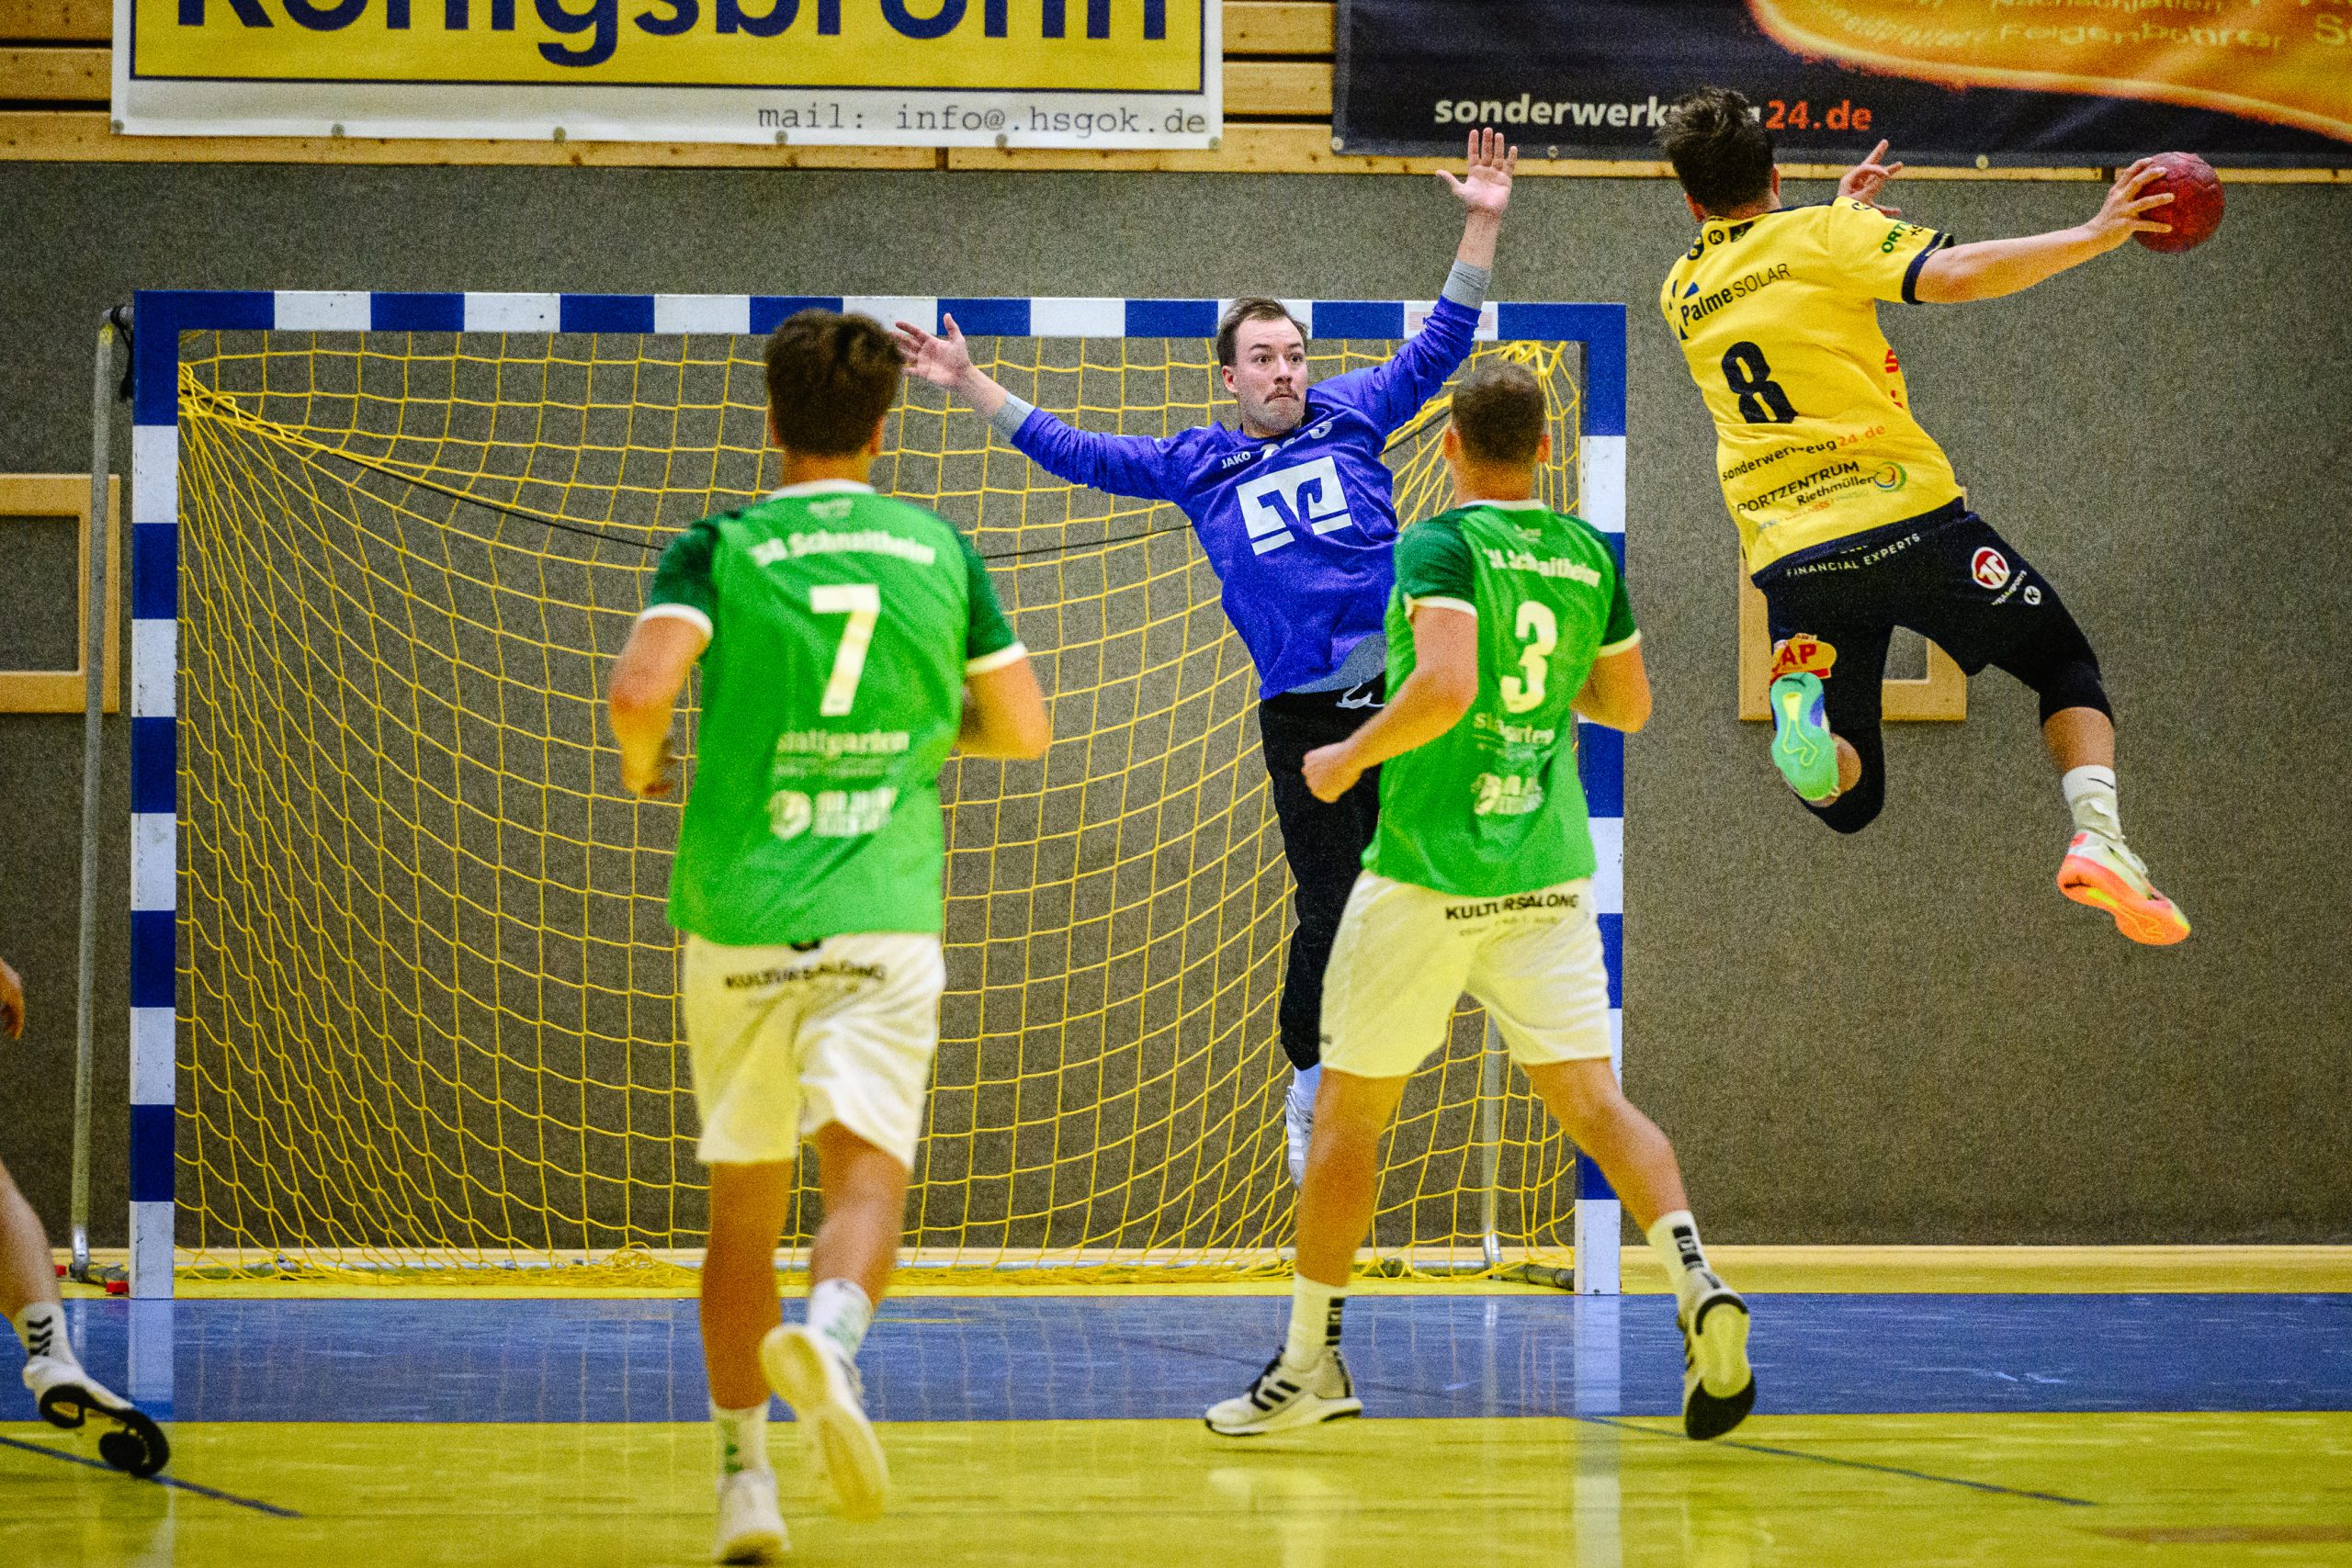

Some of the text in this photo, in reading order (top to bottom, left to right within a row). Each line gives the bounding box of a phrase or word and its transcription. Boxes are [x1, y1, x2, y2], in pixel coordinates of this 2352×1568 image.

[758, 103, 1206, 138] mail: info@.hsgok.de
[1434, 94, 1872, 132] sonderwerk24.de
[1721, 341, 1798, 423] 8
[1221, 451, 1251, 469] JAKO
[1736, 460, 1860, 514] PORTZENTRUM
[1786, 533, 1921, 578] FINANCIAL EXPERTS
[810, 583, 881, 716] 7
[1500, 600, 1557, 714] 3
